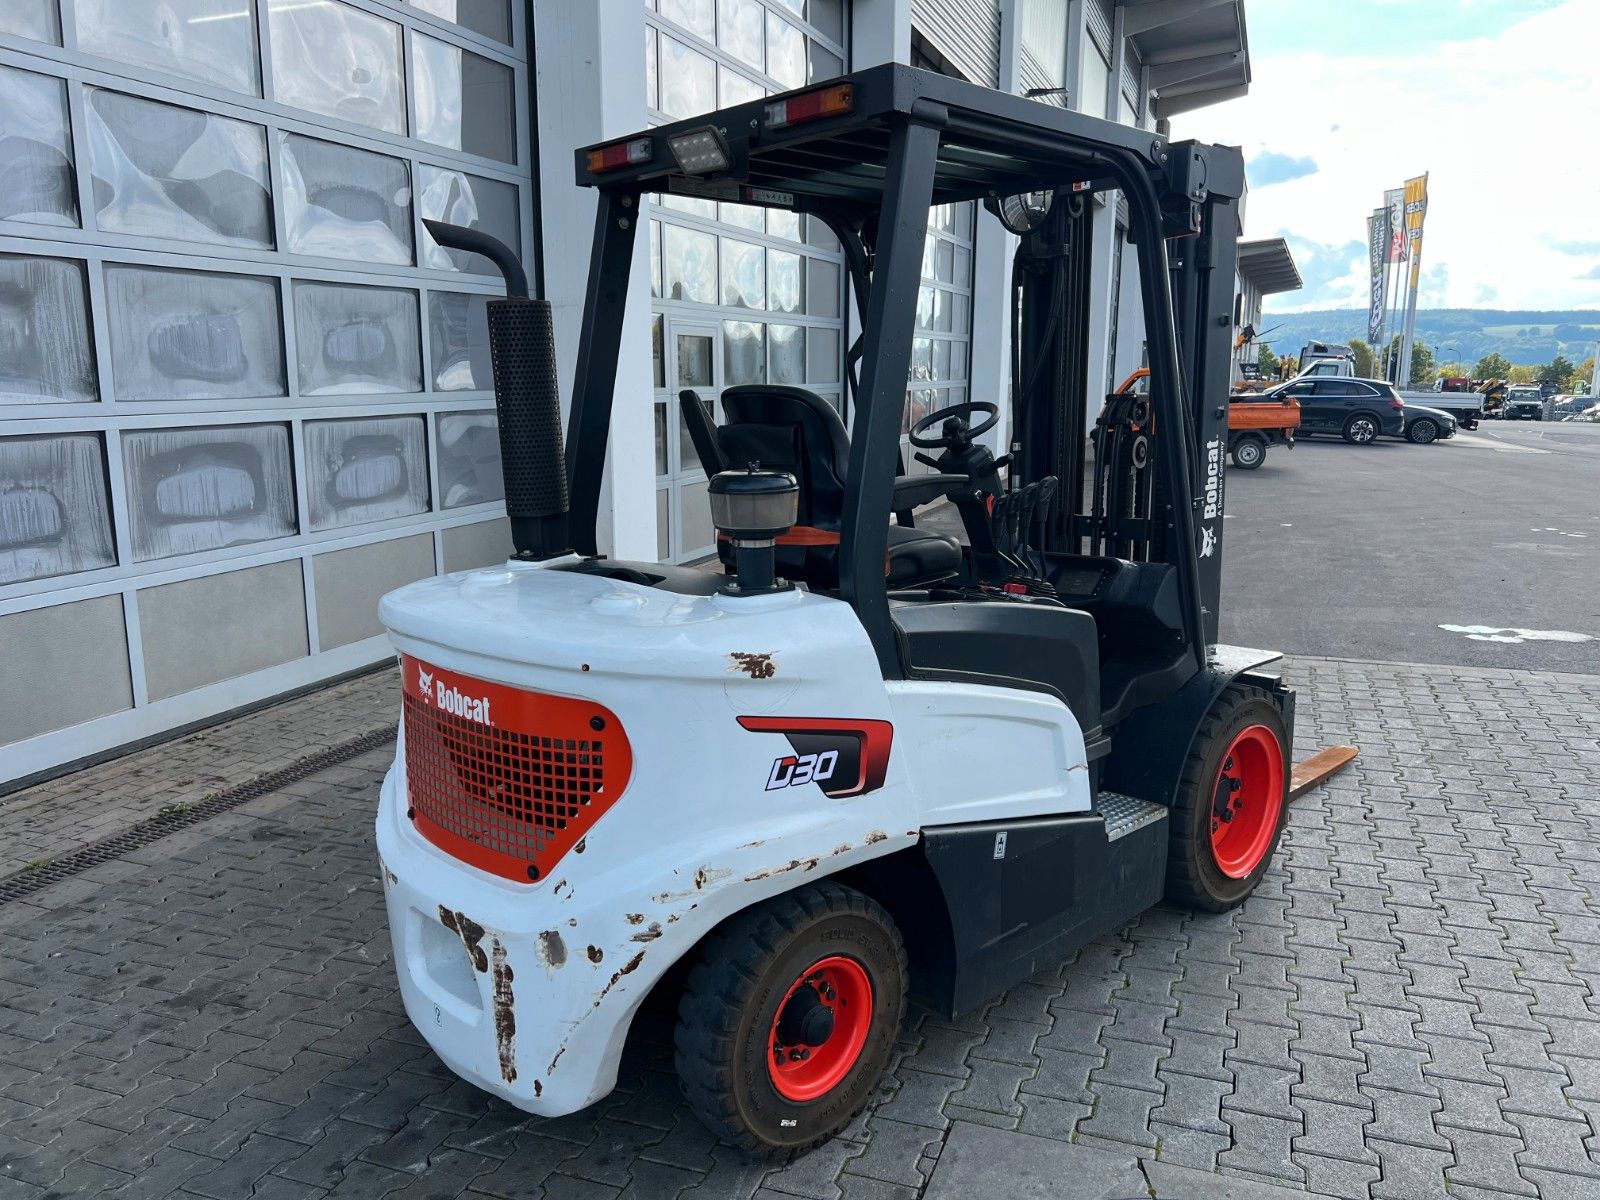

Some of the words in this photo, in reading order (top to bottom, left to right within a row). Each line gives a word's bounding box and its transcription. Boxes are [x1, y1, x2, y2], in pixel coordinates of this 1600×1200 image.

[1204, 440, 1220, 519] Bobcat
[436, 680, 491, 725] Bobcat
[765, 750, 838, 791] D30
